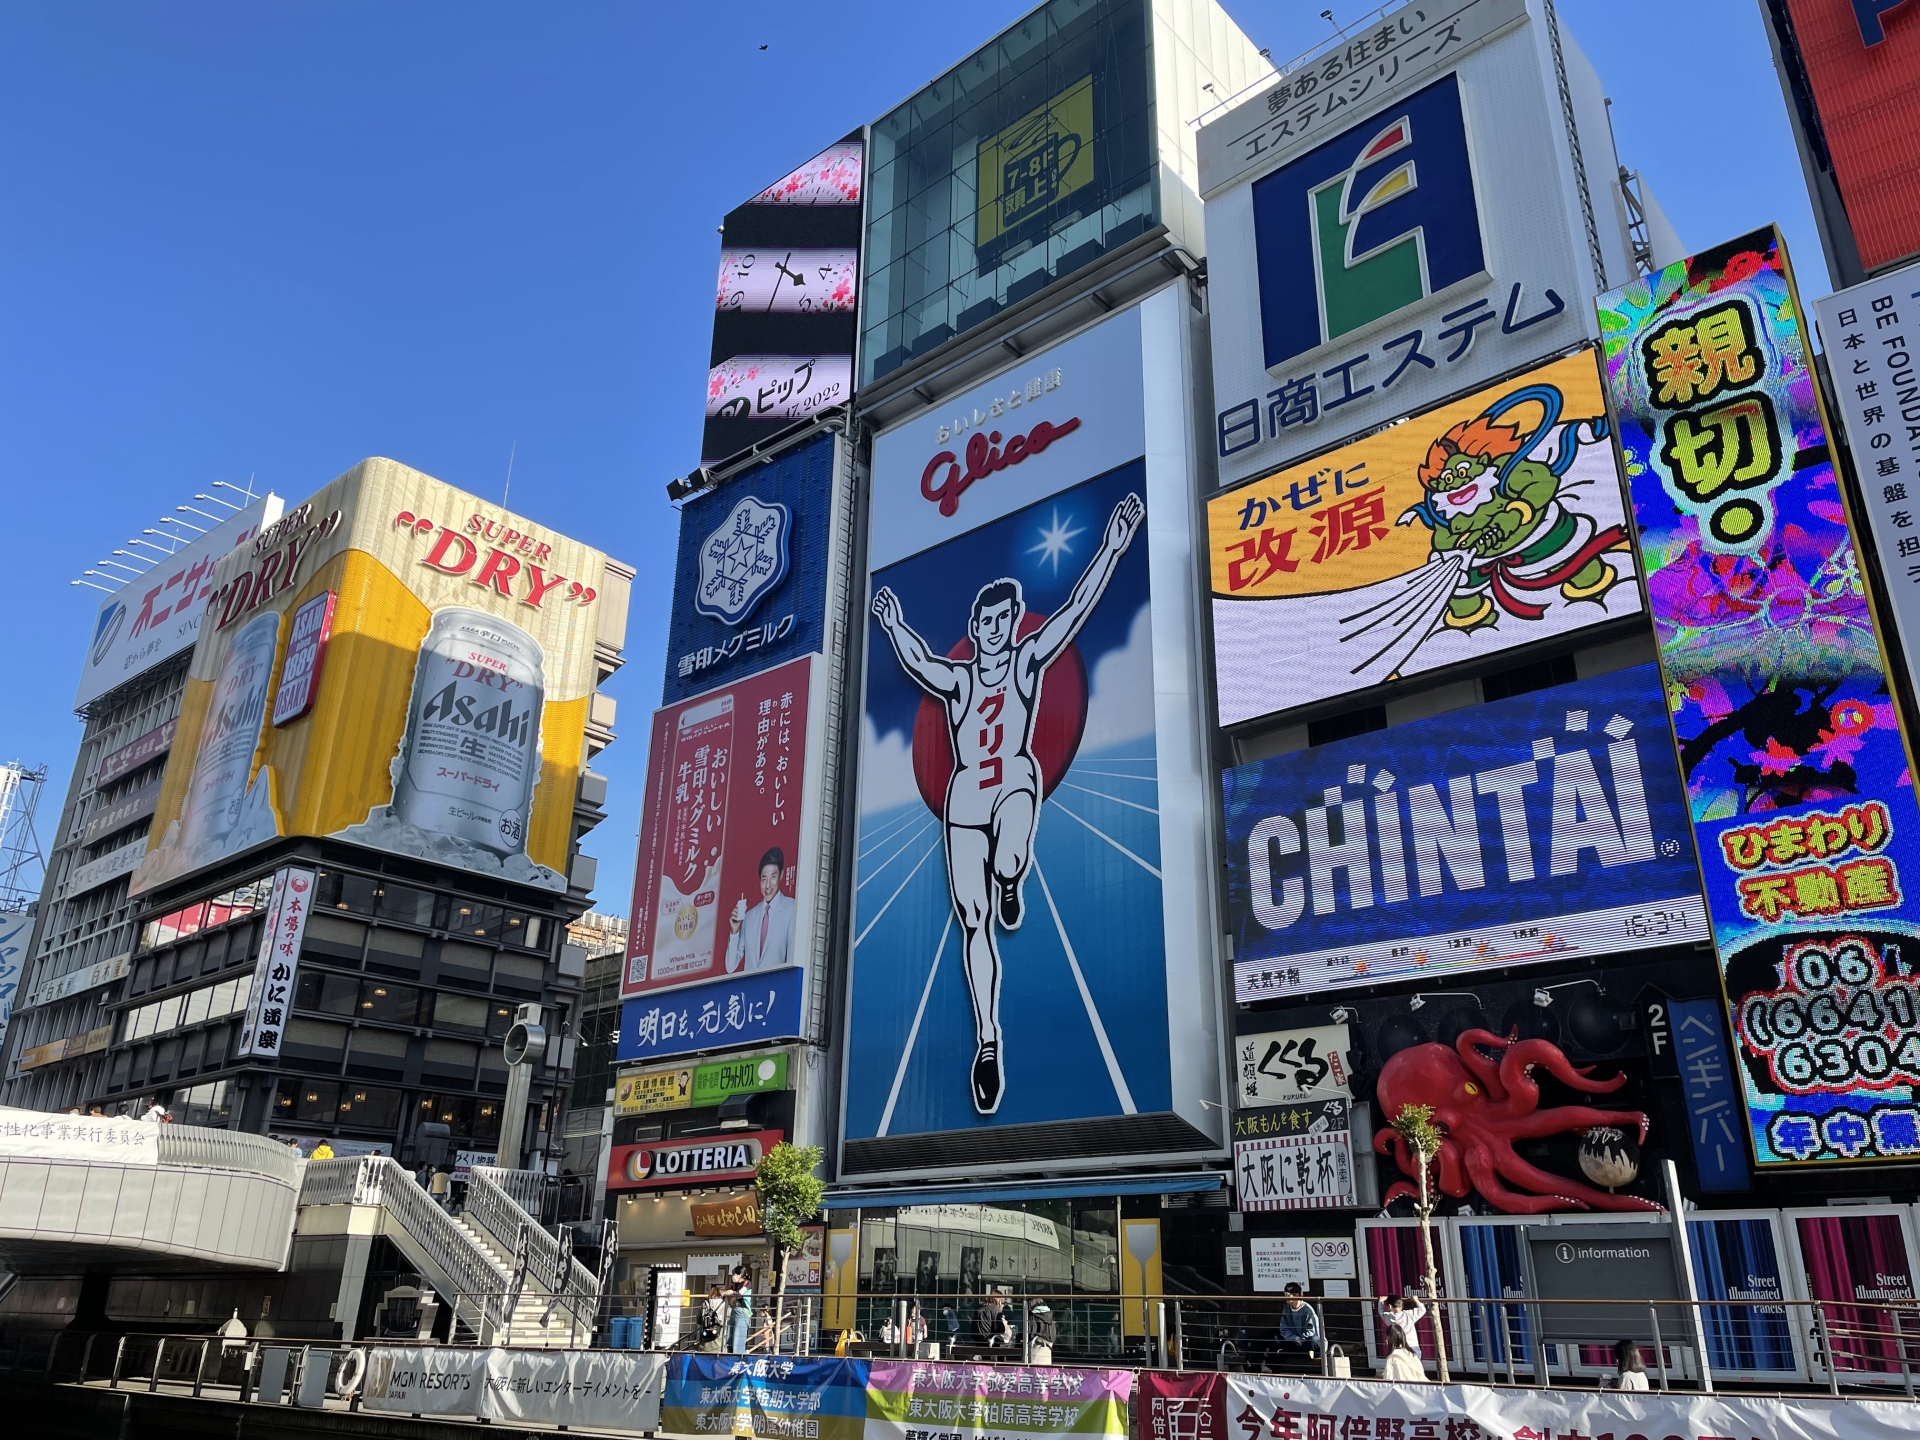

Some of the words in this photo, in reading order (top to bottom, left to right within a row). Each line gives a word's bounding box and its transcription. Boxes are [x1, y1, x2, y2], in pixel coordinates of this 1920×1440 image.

[1266, 10, 1428, 113] 夢ある住まい
[1246, 18, 1461, 160] エステムシリーズ
[1871, 295, 1900, 329] BE
[1217, 283, 1565, 458] 日商エステム
[803, 382, 841, 412] 2022
[934, 366, 1063, 445] おいしさと健康
[1238, 462, 1371, 531] かぜに
[252, 503, 312, 558] SUPER
[467, 513, 552, 561] SUPER
[1225, 486, 1390, 591] 改源
[291, 602, 325, 644] ASAHI
[283, 643, 317, 684] 1889
[469, 652, 507, 671] SUPER
[678, 614, 797, 677] 雪印メグミルク
[274, 676, 309, 718] OSAKA
[423, 680, 530, 748] Asahi
[205, 685, 264, 750] Asahi
[460, 737, 486, 760] 生
[754, 699, 773, 795] 理由がある。
[772, 692, 794, 826] 赤には、おいしい
[437, 766, 500, 792] スーパードライ
[675, 761, 693, 805] 牛乳
[706, 747, 729, 837] おいしい
[84, 818, 98, 839] 7F
[448, 806, 476, 820] 生ビール
[501, 818, 521, 840] お酒
[683, 745, 711, 884] 雪印メグミルク
[1728, 805, 1884, 867] ひまわり
[1746, 863, 1891, 918] 不動産
[279, 897, 303, 957] 本場の味
[1624, 910, 1688, 938] 16:34
[669, 955, 685, 963] Whole
[1246, 966, 1301, 991] 天気予報
[1801, 948, 1863, 986] 06
[257, 962, 291, 1049] かに道楽
[720, 1063, 755, 1090] ピタットハウス
[1242, 1041, 1258, 1097] 道頓堀
[1258, 1038, 1329, 1092] くくる
[1680, 1013, 1736, 1172] ペンギンバー
[1235, 1109, 1312, 1136] 大阪もんを食す
[1330, 1117, 1345, 1130] 2F
[656, 1144, 748, 1174] LOTTERIA
[1242, 1146, 1334, 1198] 大阪に乾杯
[1337, 1151, 1348, 1183] 検索
[1577, 1246, 1650, 1260] information
[809, 1269, 819, 1283] 8F
[1747, 1274, 1776, 1287] Street
[1876, 1272, 1907, 1286] Street
[420, 1372, 471, 1391] RESORTS
[728, 1359, 794, 1380] 東大阪大学
[911, 1368, 1083, 1396] 東大阪大学敬愛高等学校
[388, 1390, 407, 1400] JAPAN
[700, 1386, 821, 1411] 東大阪大学短期大学部
[908, 1398, 1080, 1428] 東大阪大学柏原高等学校
[695, 1413, 819, 1439] 東大阪大学附属幼稚園
[1151, 1397, 1167, 1440] 阿倍
